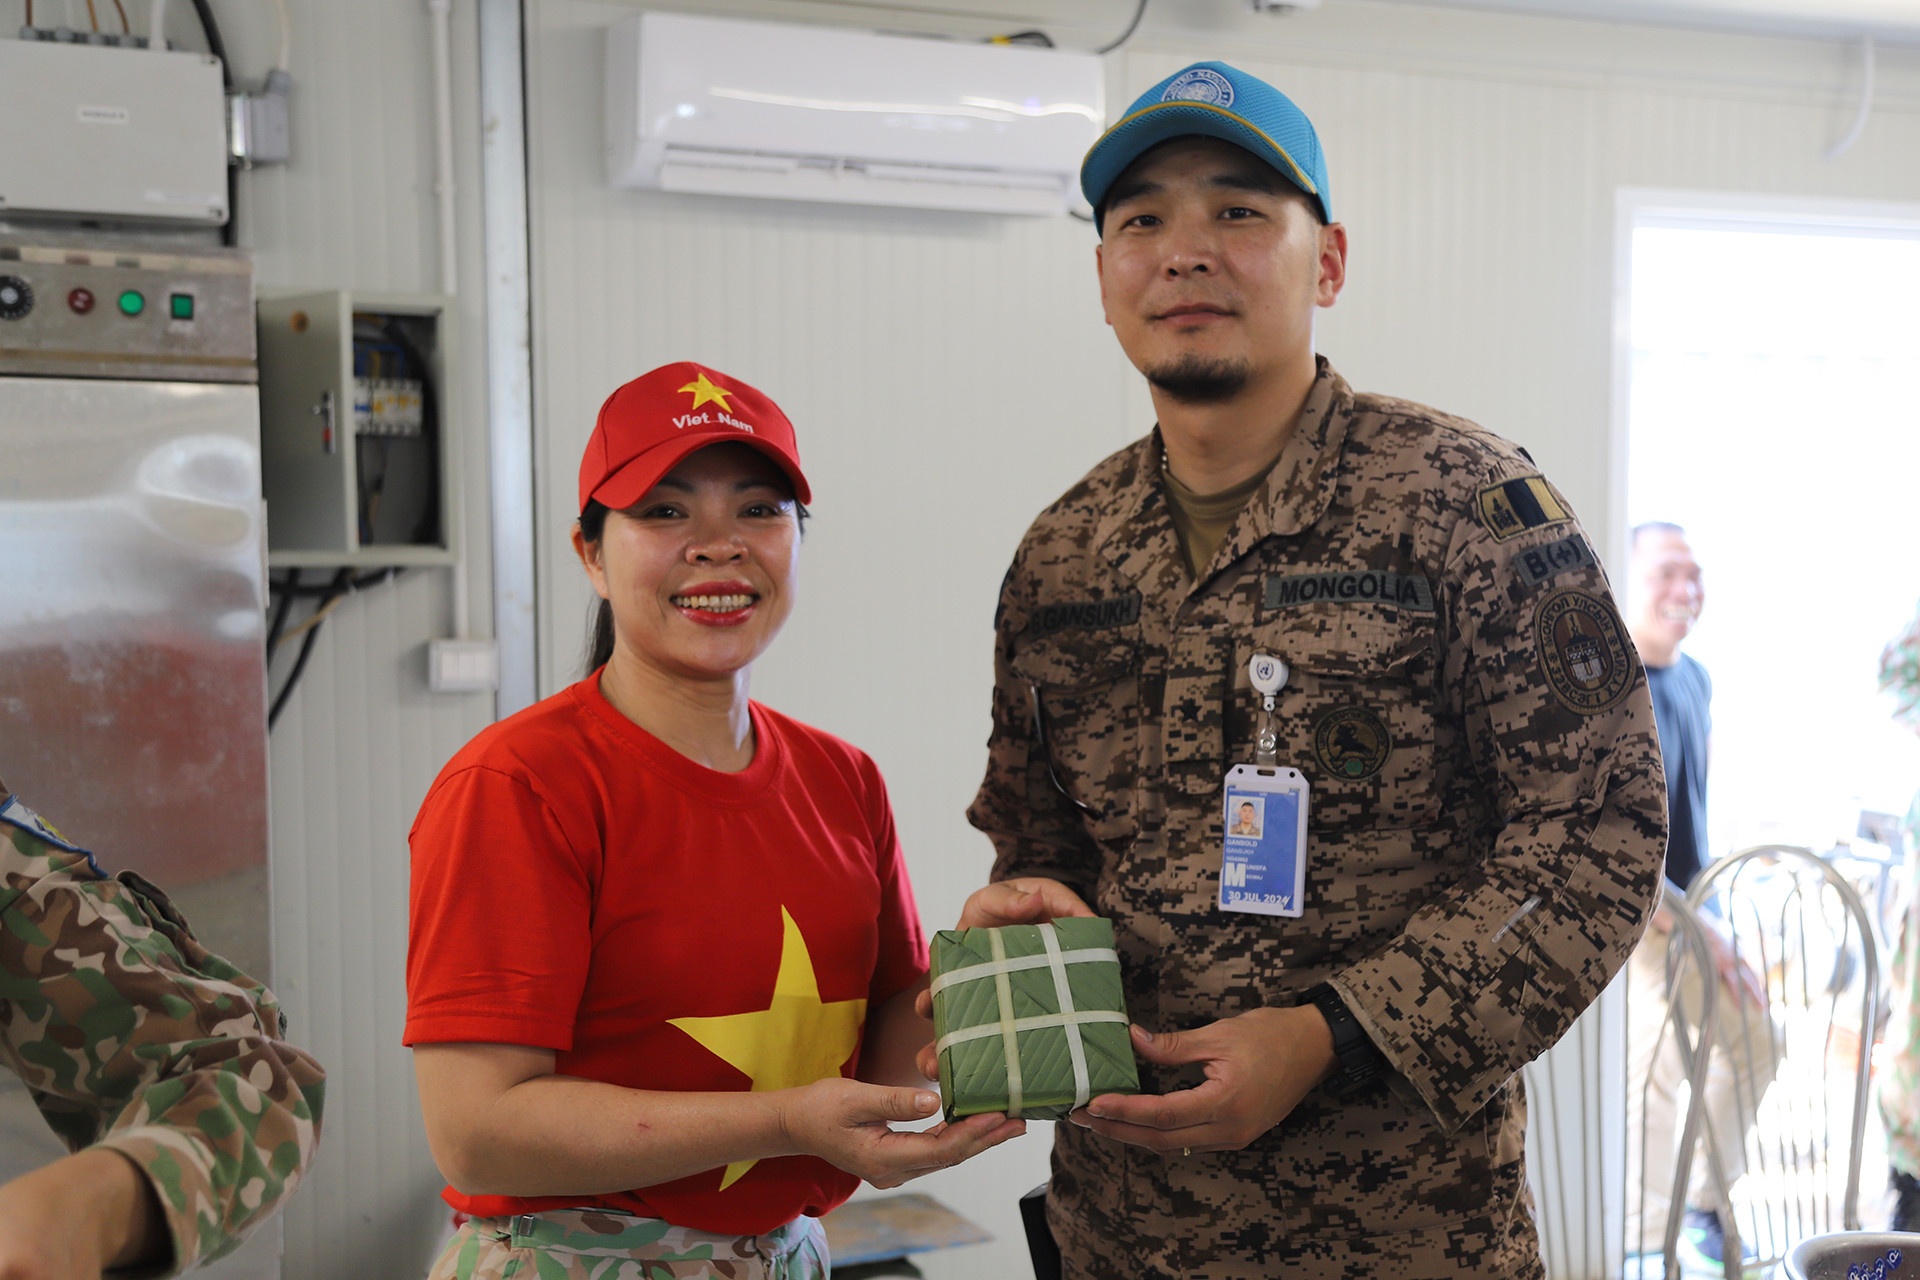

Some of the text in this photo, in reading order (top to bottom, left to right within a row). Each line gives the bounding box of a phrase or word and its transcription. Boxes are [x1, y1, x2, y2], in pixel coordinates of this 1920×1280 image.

[672, 411, 755, 434] Viet Nam
[1524, 540, 1582, 579] B(+)
[1279, 572, 1420, 605] MONGOLIA
[1224, 862, 1246, 887] M
[1228, 890, 1241, 900] 30
[1243, 892, 1261, 902] JUL
